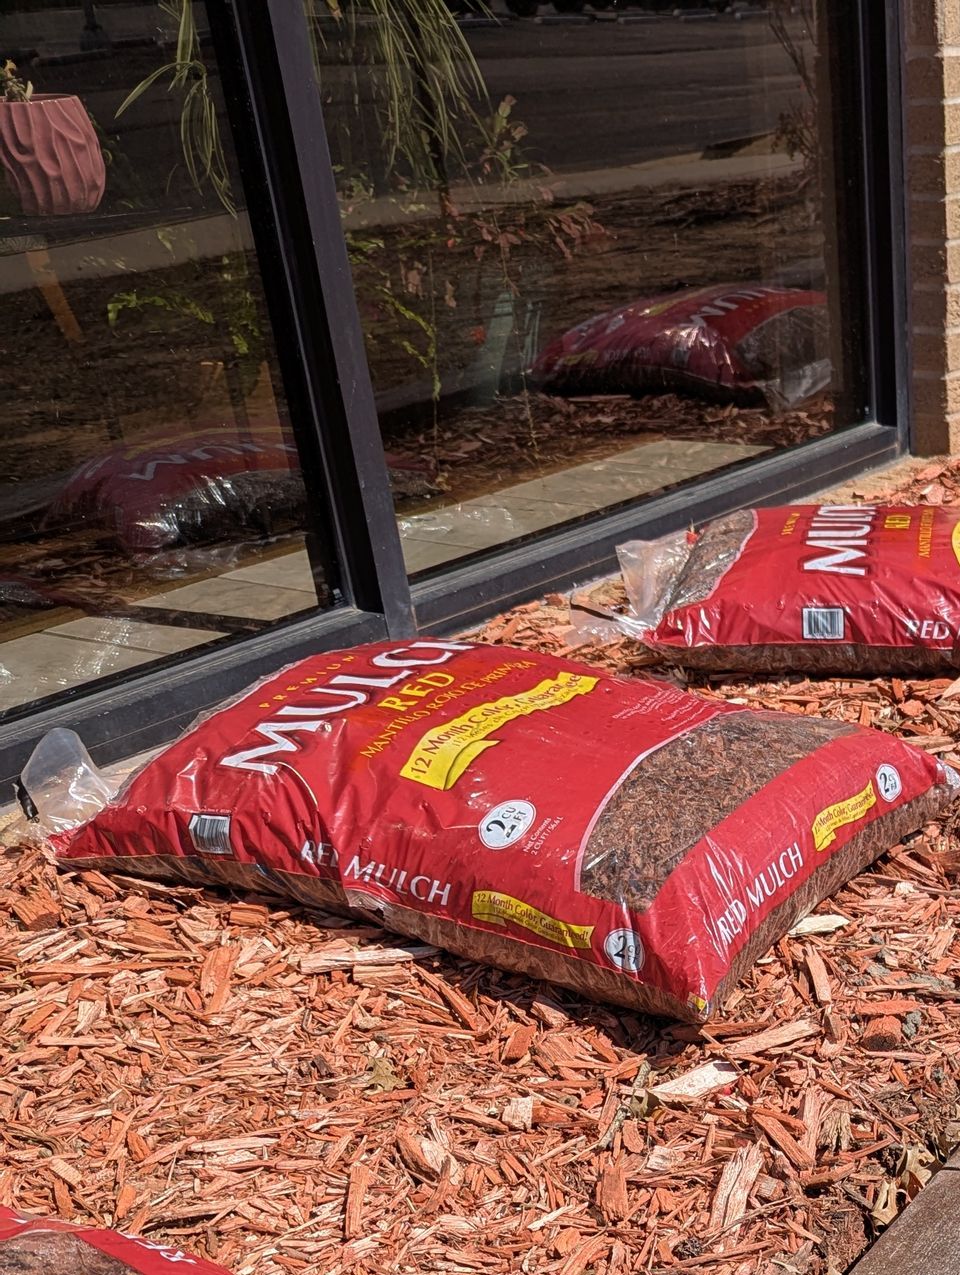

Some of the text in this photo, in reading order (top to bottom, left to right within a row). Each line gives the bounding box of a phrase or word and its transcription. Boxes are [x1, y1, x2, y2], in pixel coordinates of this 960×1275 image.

[905, 619, 951, 640] RED
[258, 655, 355, 709] PREMIUM
[377, 672, 455, 712] RED
[360, 710, 431, 759] MANTILLO
[460, 680, 487, 691] DE
[411, 757, 433, 775] 12
[422, 720, 474, 755] Month
[880, 773, 890, 793] 2
[501, 806, 517, 820] CU
[513, 810, 527, 822] FT
[819, 811, 834, 828] Month
[486, 820, 517, 839] 2
[522, 840, 535, 853] Net
[533, 839, 544, 851] CU
[344, 855, 451, 906] MULCH
[716, 841, 804, 947] RED MULCH
[476, 893, 487, 903] 12
[487, 893, 514, 911] Month
[514, 904, 538, 925] Color,
[613, 935, 628, 960] 2
